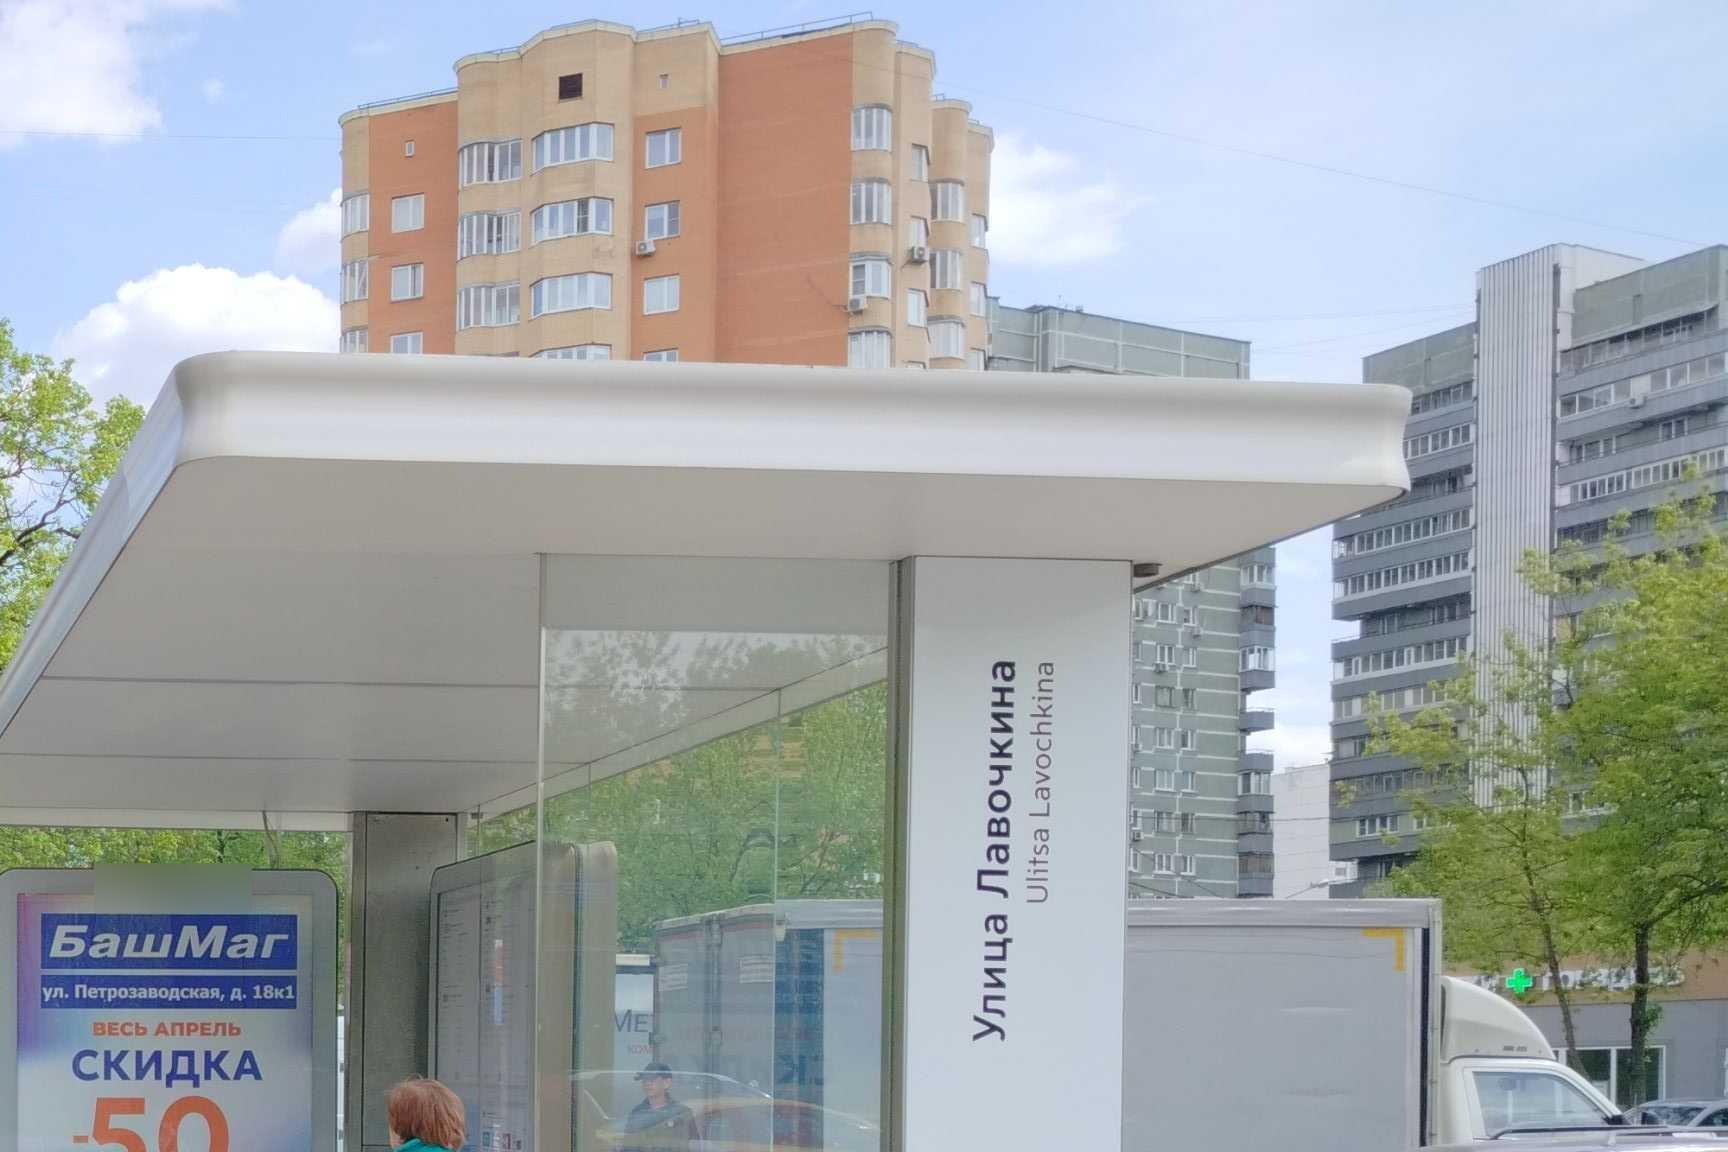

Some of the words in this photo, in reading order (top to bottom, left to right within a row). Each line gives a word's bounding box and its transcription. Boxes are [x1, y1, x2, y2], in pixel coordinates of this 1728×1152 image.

[1029, 660, 1055, 817] Lavochkina
[976, 659, 1017, 900] Лавочкина
[1025, 827, 1050, 903] Ulitsa
[49, 924, 289, 959] БашМаг
[42, 986, 69, 1001] ул.
[75, 984, 225, 1001] Петрозаводская,
[230, 986, 246, 1001] д.
[252, 985, 295, 999] 18к1
[972, 912, 1013, 1042] Улица
[92, 1022, 147, 1037] ВЕСЬ
[154, 1021, 242, 1037] АПРЕЛЬ
[72, 1049, 263, 1088] СКИДКА
